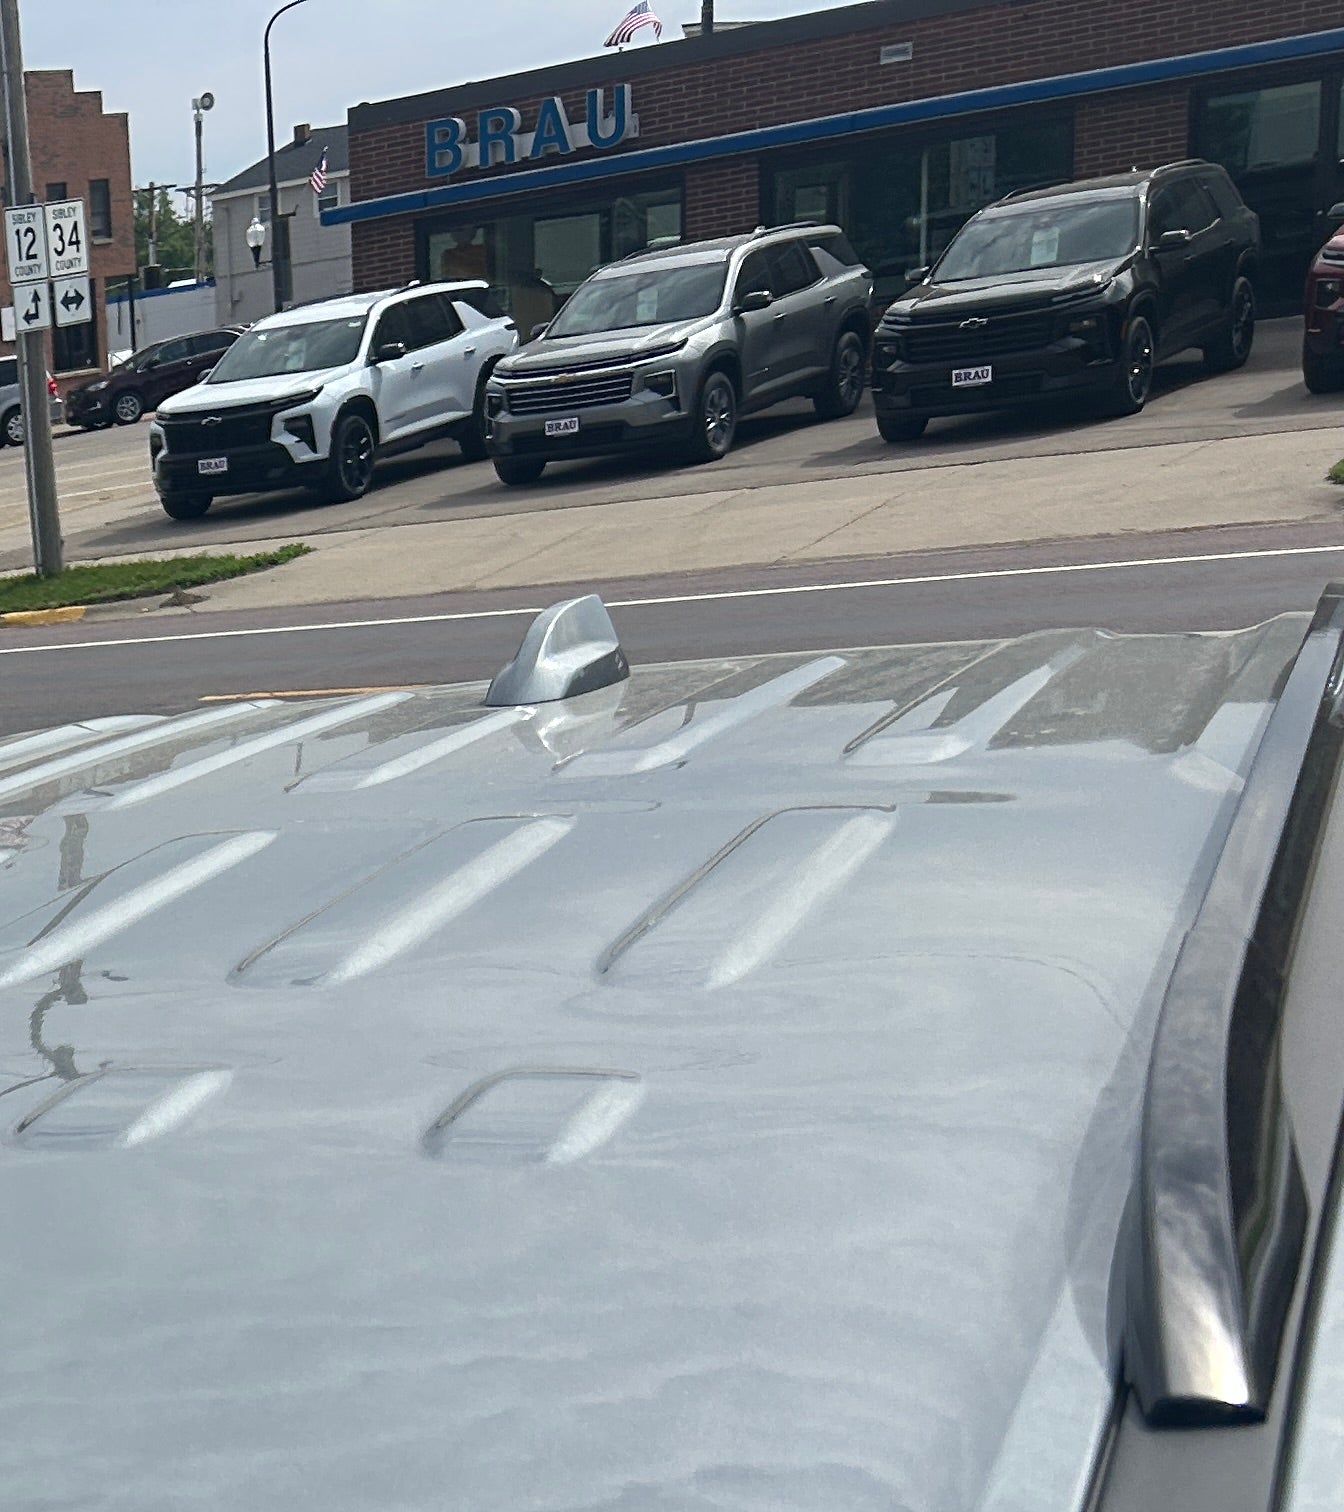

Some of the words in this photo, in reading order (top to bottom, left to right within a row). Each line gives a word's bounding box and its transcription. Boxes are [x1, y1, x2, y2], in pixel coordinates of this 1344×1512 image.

[425, 83, 632, 178] BRAU
[12, 211, 37, 225] SIBLEY
[53, 206, 77, 220] SIBLEY
[15, 226, 38, 262] 12
[53, 220, 81, 257] 34
[14, 263, 42, 277] COUNTY
[55, 257, 82, 271] COUNTY
[954, 368, 990, 384] BRAU
[546, 419, 577, 433] BRAU
